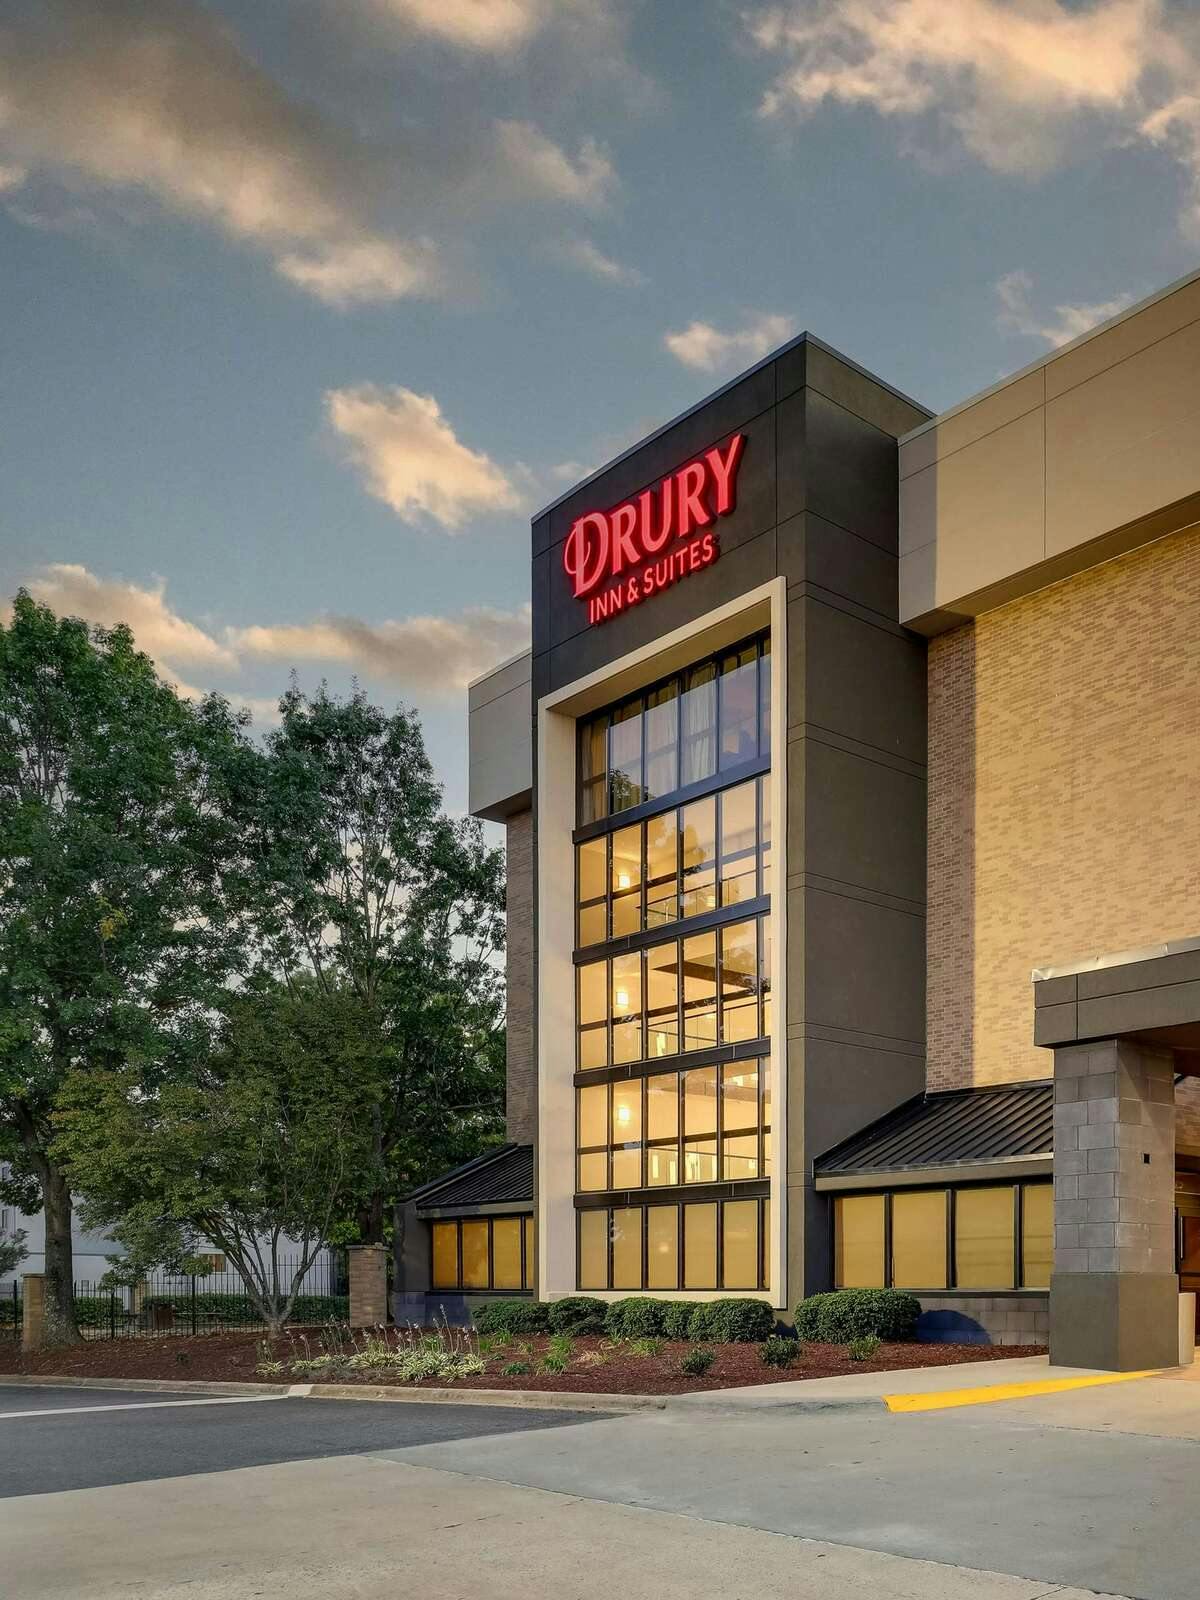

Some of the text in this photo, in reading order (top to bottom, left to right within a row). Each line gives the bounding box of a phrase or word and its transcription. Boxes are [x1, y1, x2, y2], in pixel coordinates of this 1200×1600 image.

[564, 434, 743, 599] DRURY
[590, 533, 714, 624] INN & SUITES
